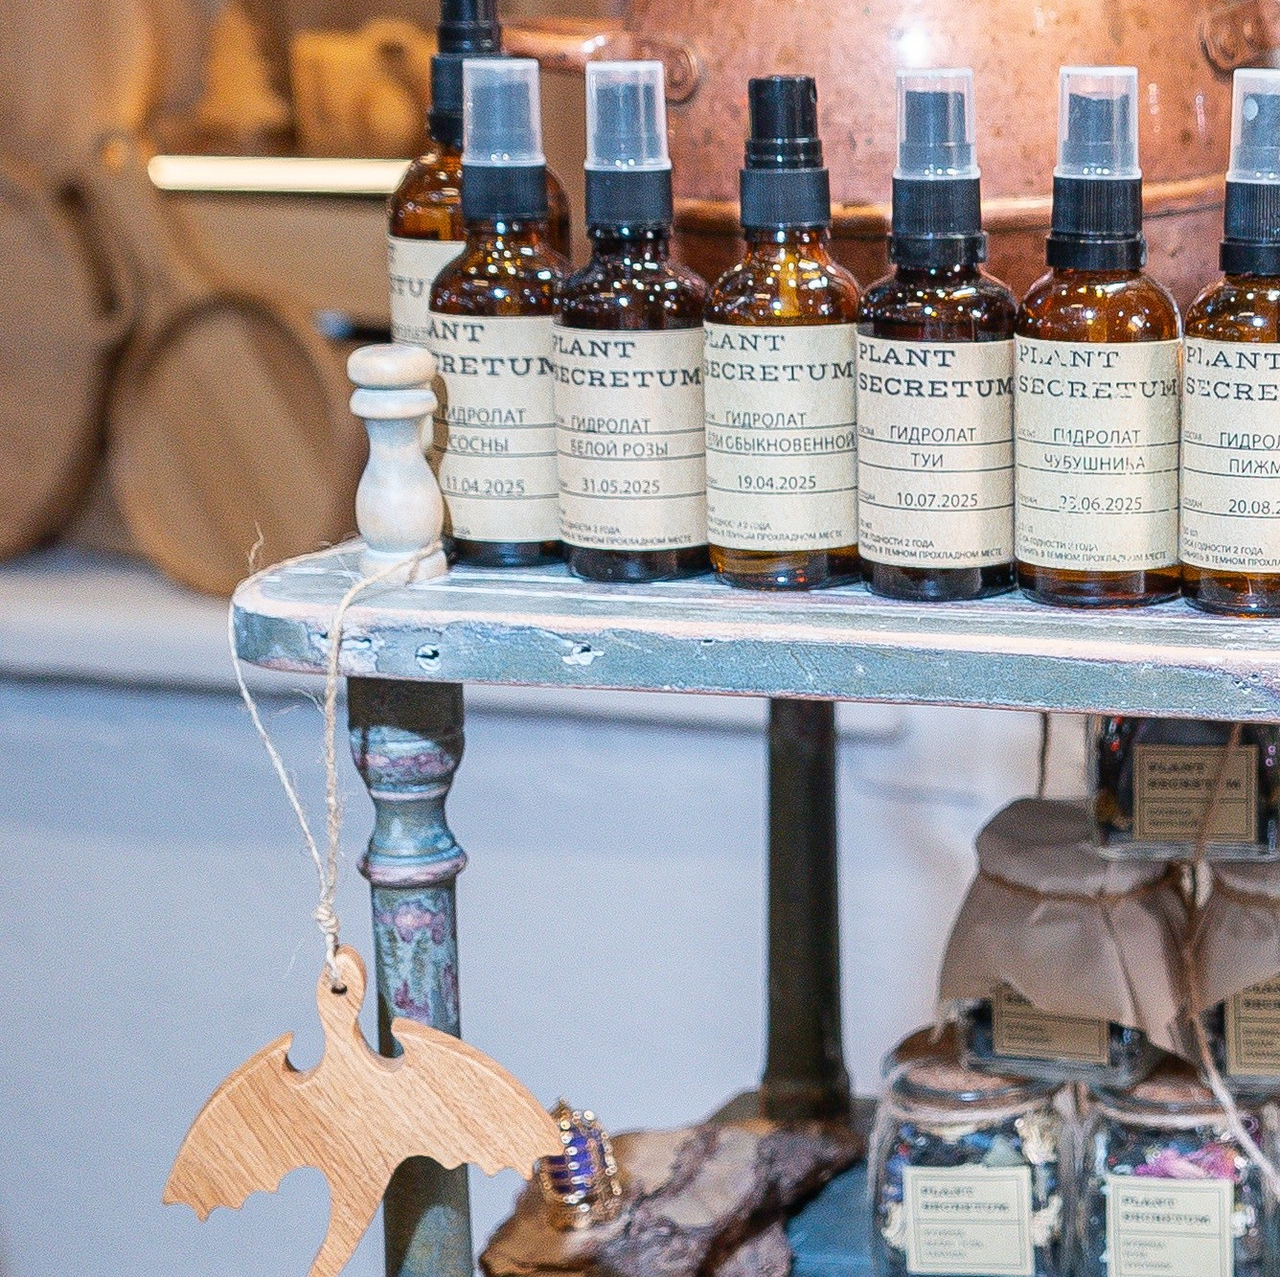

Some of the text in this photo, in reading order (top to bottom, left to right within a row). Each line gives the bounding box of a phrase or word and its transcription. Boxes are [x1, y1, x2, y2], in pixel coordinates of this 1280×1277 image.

[428, 319, 485, 343] ANT
[859, 342, 956, 368] PLANT
[1019, 344, 1119, 369] PLANT
[859, 372, 1013, 398] SECRETUM
[1019, 376, 1177, 399] SECRETUM
[571, 414, 650, 434] ГИДРОЛАТ
[725, 411, 807, 428] ГИДРОЛАТ
[449, 434, 510, 453] СОСНЫ
[725, 433, 856, 453] ОБЫКНОВЕННОЙ
[890, 425, 977, 444] ГИДРОЛАТ
[1053, 427, 1141, 446] ГИДРОЛАТ
[571, 437, 668, 457] БЕЛОЙ РОЗЫ
[911, 453, 944, 468] ТУИ
[582, 477, 660, 494] 31.05.2025
[737, 474, 817, 491] 19.04.2025
[897, 492, 978, 508] 10.07.2025
